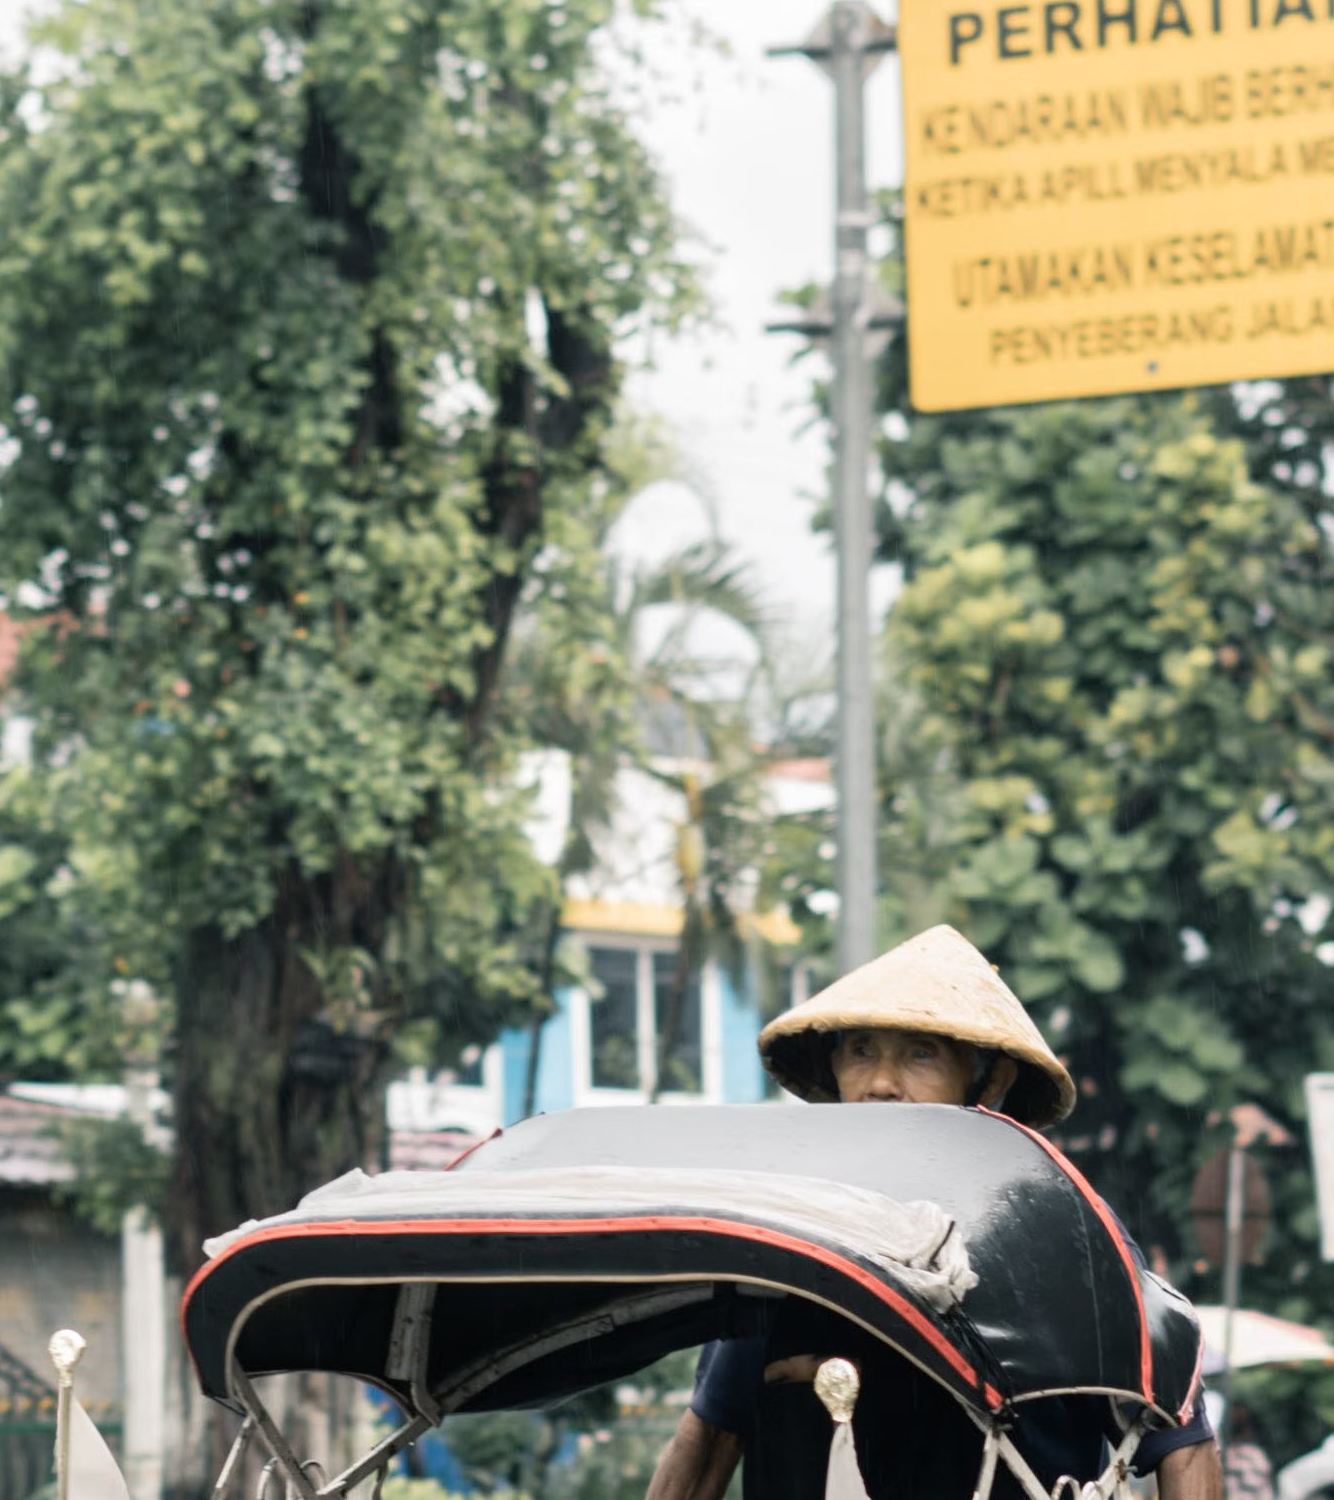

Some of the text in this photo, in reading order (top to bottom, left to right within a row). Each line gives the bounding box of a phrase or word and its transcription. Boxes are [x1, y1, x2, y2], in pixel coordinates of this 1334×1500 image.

[921, 86, 1128, 155] KENDARAAN
[1141, 73, 1234, 131] WAJIB
[915, 173, 1029, 218] KETIKA
[1040, 160, 1124, 202] APILL
[1135, 142, 1289, 192] MENYALA
[952, 243, 1134, 308] UTAMAKAN
[990, 304, 1233, 366] PENYEBERANG
